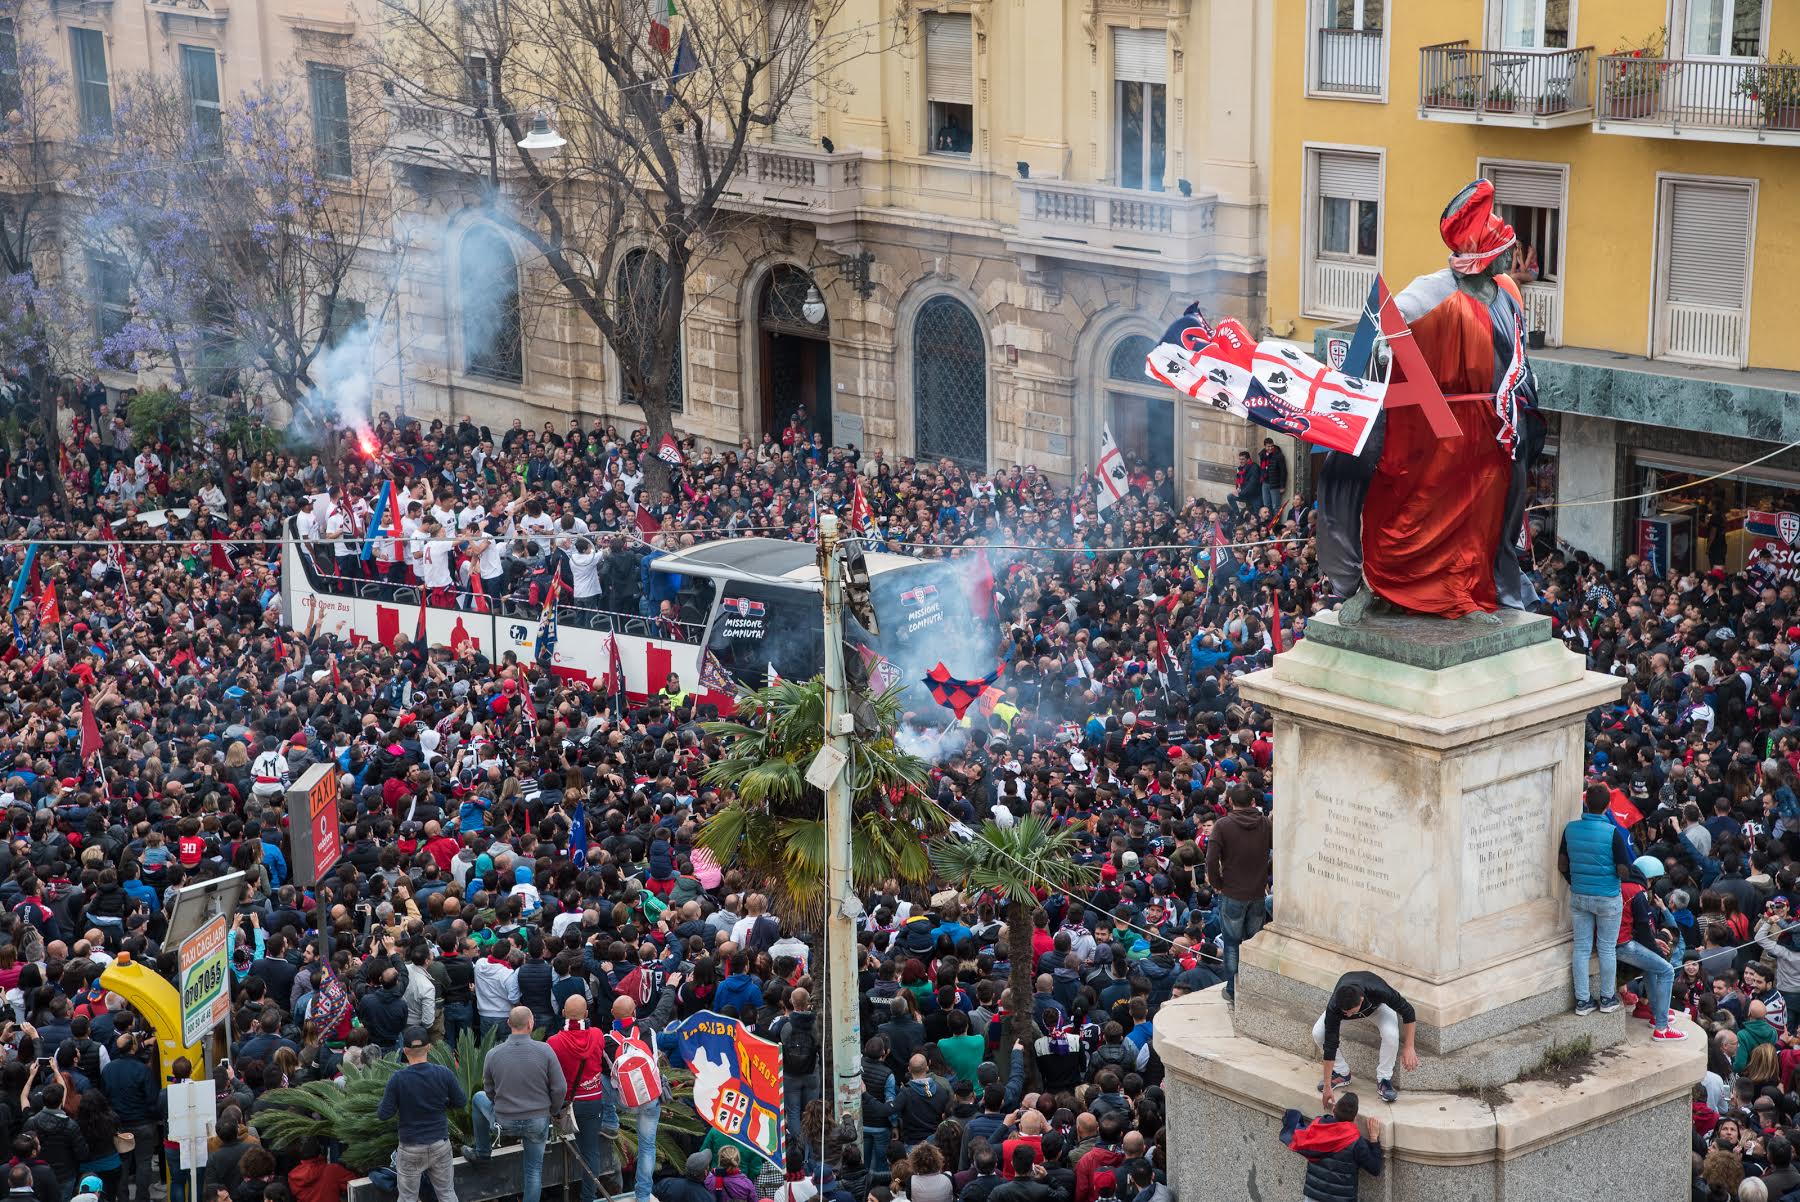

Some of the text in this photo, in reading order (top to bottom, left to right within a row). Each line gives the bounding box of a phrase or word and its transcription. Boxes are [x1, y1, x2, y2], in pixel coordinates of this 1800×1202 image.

[337, 602, 350, 612] Bus
[908, 602, 941, 622] MISSIONE
[724, 618, 763, 629] MISSIONE
[310, 769, 334, 813] TAXI
[181, 842, 197, 854] 30
[181, 944, 197, 968] TAXI
[196, 925, 225, 958] CAGLIARI
